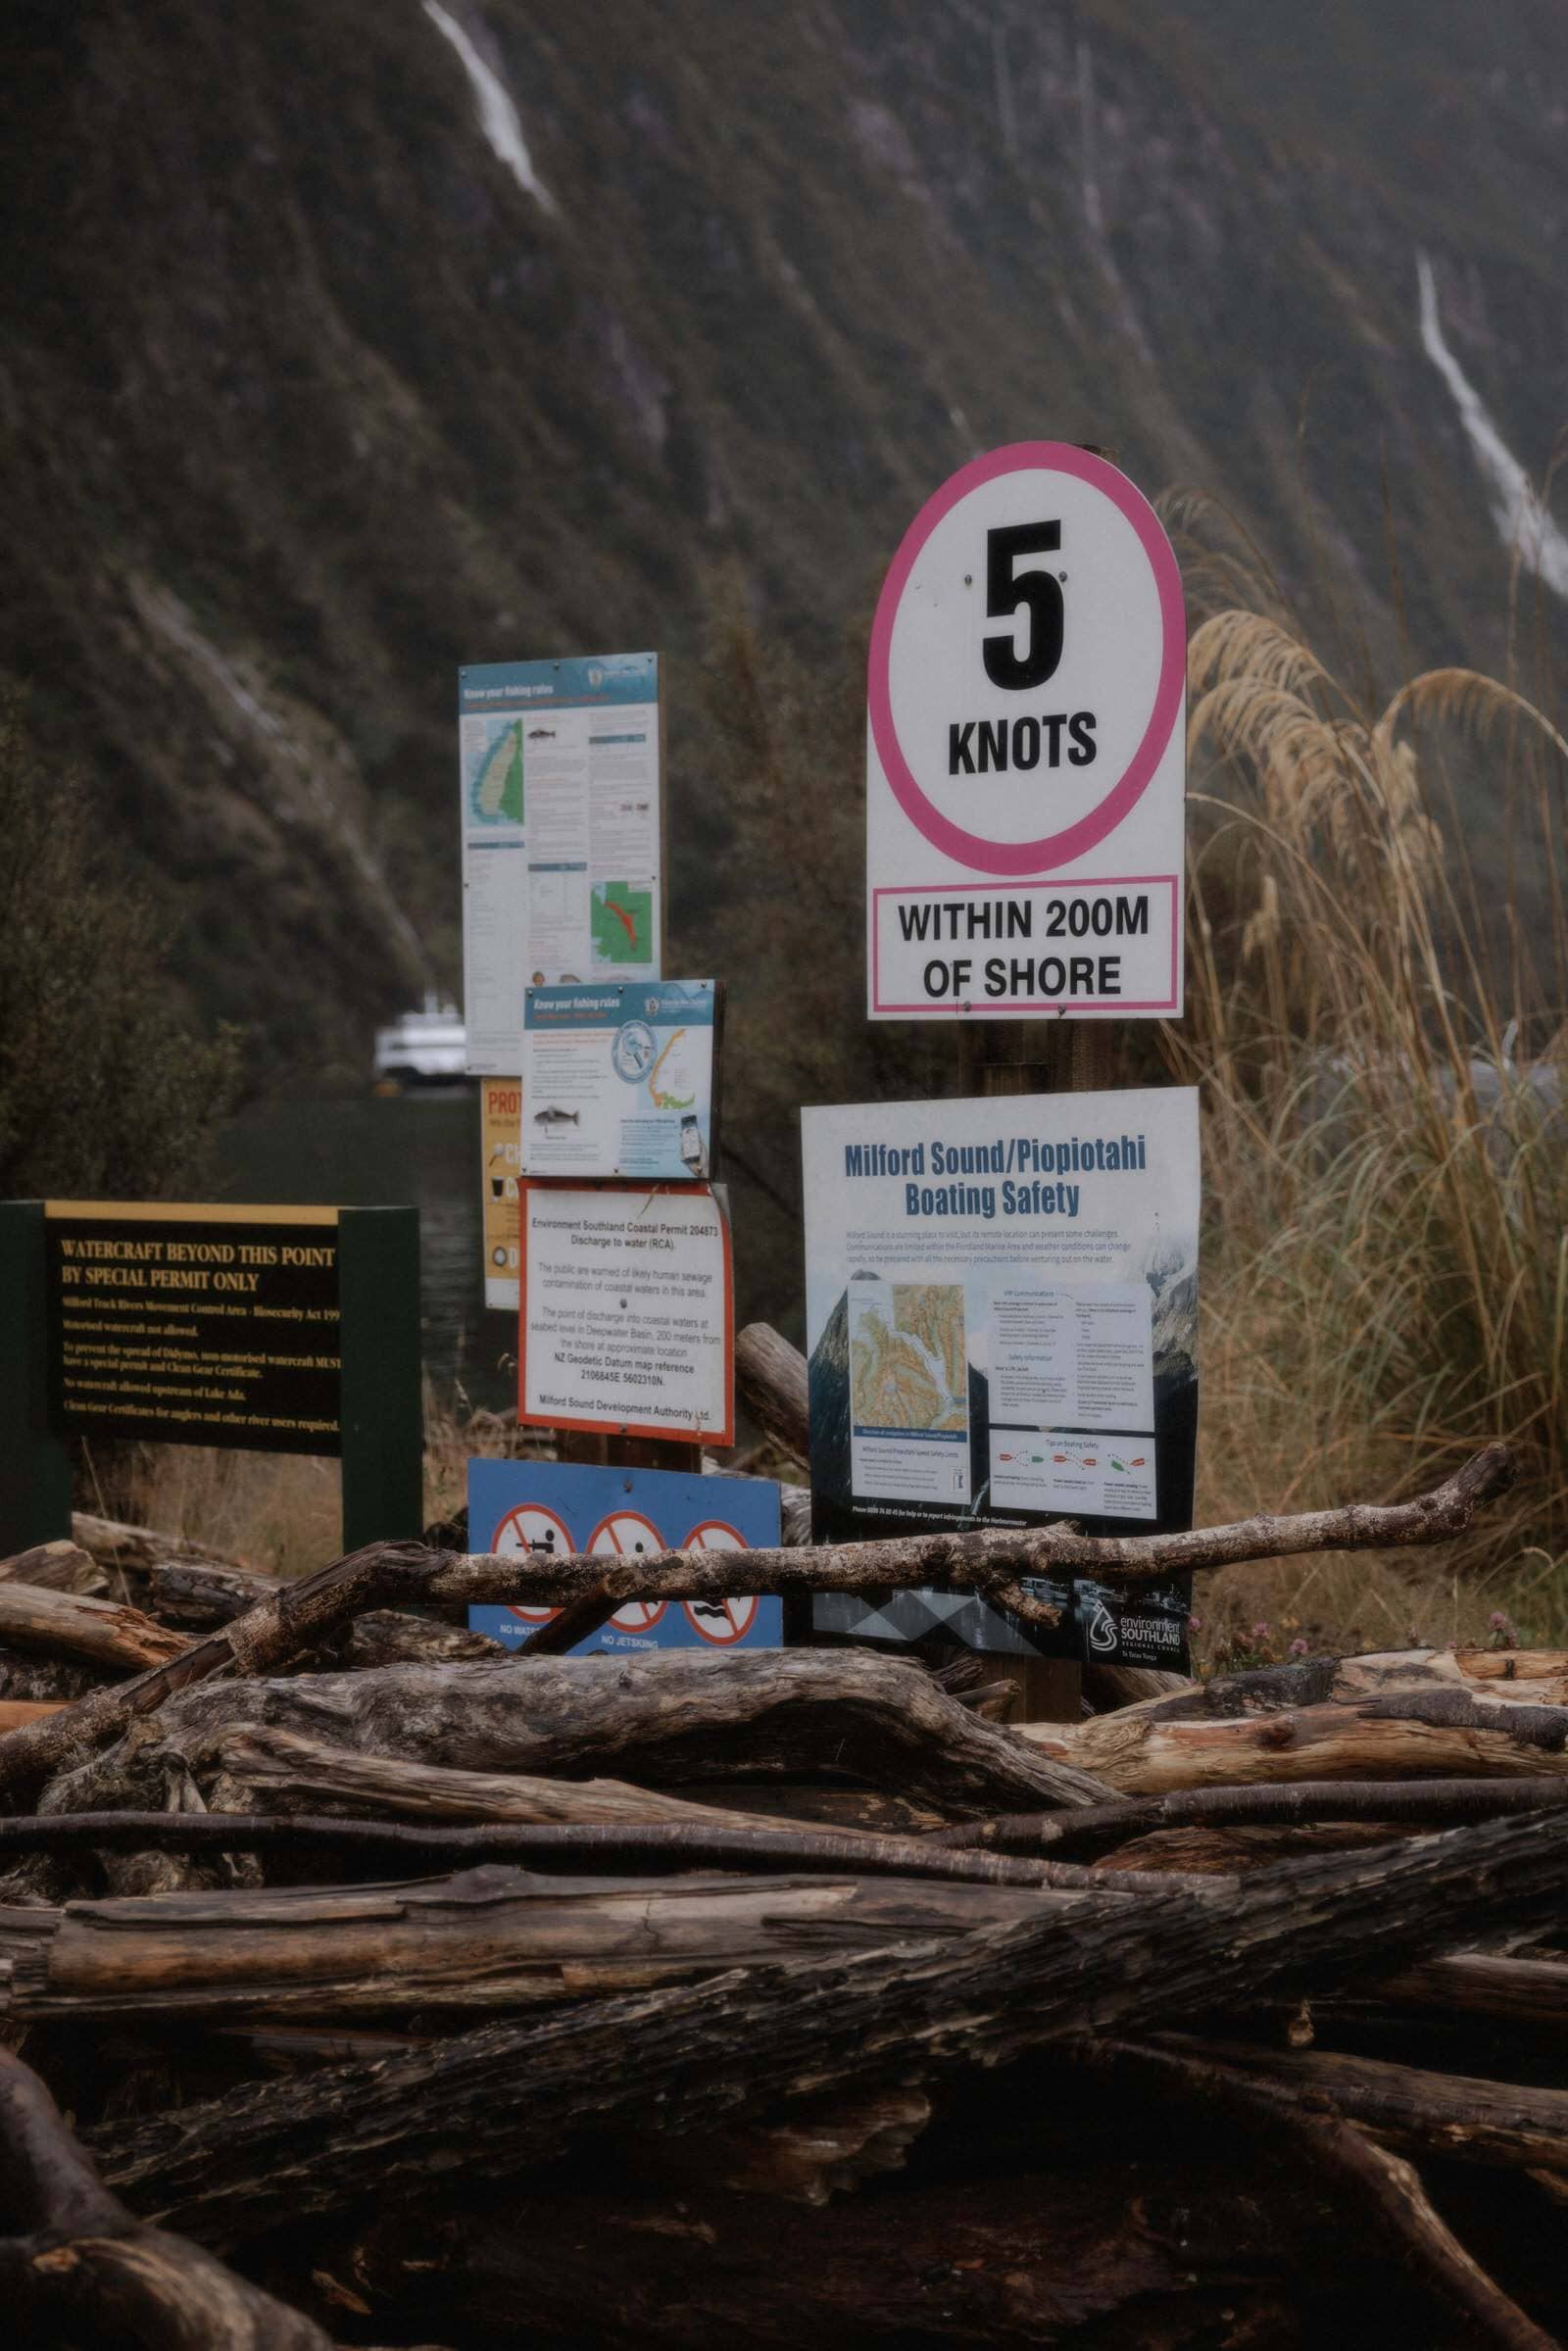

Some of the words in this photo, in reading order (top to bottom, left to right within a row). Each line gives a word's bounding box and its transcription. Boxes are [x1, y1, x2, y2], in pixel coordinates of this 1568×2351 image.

[983, 519, 1064, 690] 5
[464, 688, 486, 699] Know
[486, 688, 503, 699] your
[505, 685, 531, 697] fishing
[532, 684, 554, 694] rules
[949, 711, 1097, 775] KNOTS
[899, 901, 1032, 941] WITHIN
[1046, 896, 1149, 937] 200M
[924, 960, 971, 998] OF
[984, 956, 1121, 997] SHORE
[534, 999, 553, 1009] Know
[555, 1000, 572, 1011] your
[574, 998, 599, 1009] fishing
[600, 998, 619, 1007] rules
[845, 1143, 924, 1177] Milford
[932, 1135, 1146, 1176] Sound/Piopiotahi
[906, 1182, 995, 1219] Boating
[1004, 1181, 1080, 1217] Safety
[532, 1218, 580, 1230] Environment
[583, 1220, 625, 1232] Southland
[627, 1222, 659, 1233] Coastal
[661, 1224, 688, 1235] Permit
[571, 1234, 612, 1248] Discharge
[612, 1237, 622, 1247] to
[625, 1237, 647, 1248] water
[61, 1241, 164, 1261] WATERCRAFT
[167, 1244, 235, 1263] BEYOND
[238, 1246, 277, 1264] THIS
[281, 1247, 336, 1266] POINT
[62, 1266, 81, 1285] BY
[84, 1267, 148, 1287] SPECIAL
[150, 1269, 211, 1289] PERMIT
[213, 1271, 260, 1291] ONLY
[539, 1262, 552, 1273] The
[554, 1263, 574, 1277] public
[591, 1265, 620, 1277] warned
[621, 1267, 630, 1278] of
[631, 1267, 651, 1281] likely
[653, 1268, 680, 1281] human
[682, 1273, 712, 1285] sewage
[542, 1278, 593, 1291] contamination
[595, 1282, 604, 1292] of
[604, 1282, 633, 1294] coastal
[634, 1284, 661, 1295] waters
[662, 1286, 669, 1296] in
[671, 1286, 685, 1297] this
[543, 1306, 557, 1318] The
[558, 1307, 576, 1321] point
[577, 1309, 585, 1320] of
[586, 1309, 624, 1325] discharge
[626, 1312, 641, 1324] into
[643, 1313, 670, 1325] coastal
[672, 1315, 699, 1327] waters
[700, 1317, 709, 1328] at
[559, 1324, 576, 1335] level
[577, 1325, 585, 1335] in
[586, 1325, 628, 1340] Deepwater
[657, 1330, 672, 1341] 200
[673, 1331, 701, 1343] meters
[703, 1333, 721, 1345] from
[561, 1339, 572, 1349] the
[574, 1340, 595, 1350] shore
[597, 1342, 604, 1351] at
[607, 1343, 655, 1356] approximate
[657, 1346, 688, 1357] location
[555, 1352, 565, 1363] NZ
[566, 1353, 603, 1366] Geodetic
[605, 1356, 633, 1368] Datum
[635, 1361, 653, 1372] map
[655, 1359, 694, 1373] reference
[539, 1395, 566, 1407] Milford
[568, 1397, 594, 1409] Sound
[596, 1399, 652, 1417] Development
[654, 1405, 693, 1420] Authority
[501, 1625, 512, 1634] NO
[1121, 1616, 1180, 1632] environment
[602, 1635, 613, 1645] NO
[1121, 1629, 1180, 1645] SOUTHLAND
